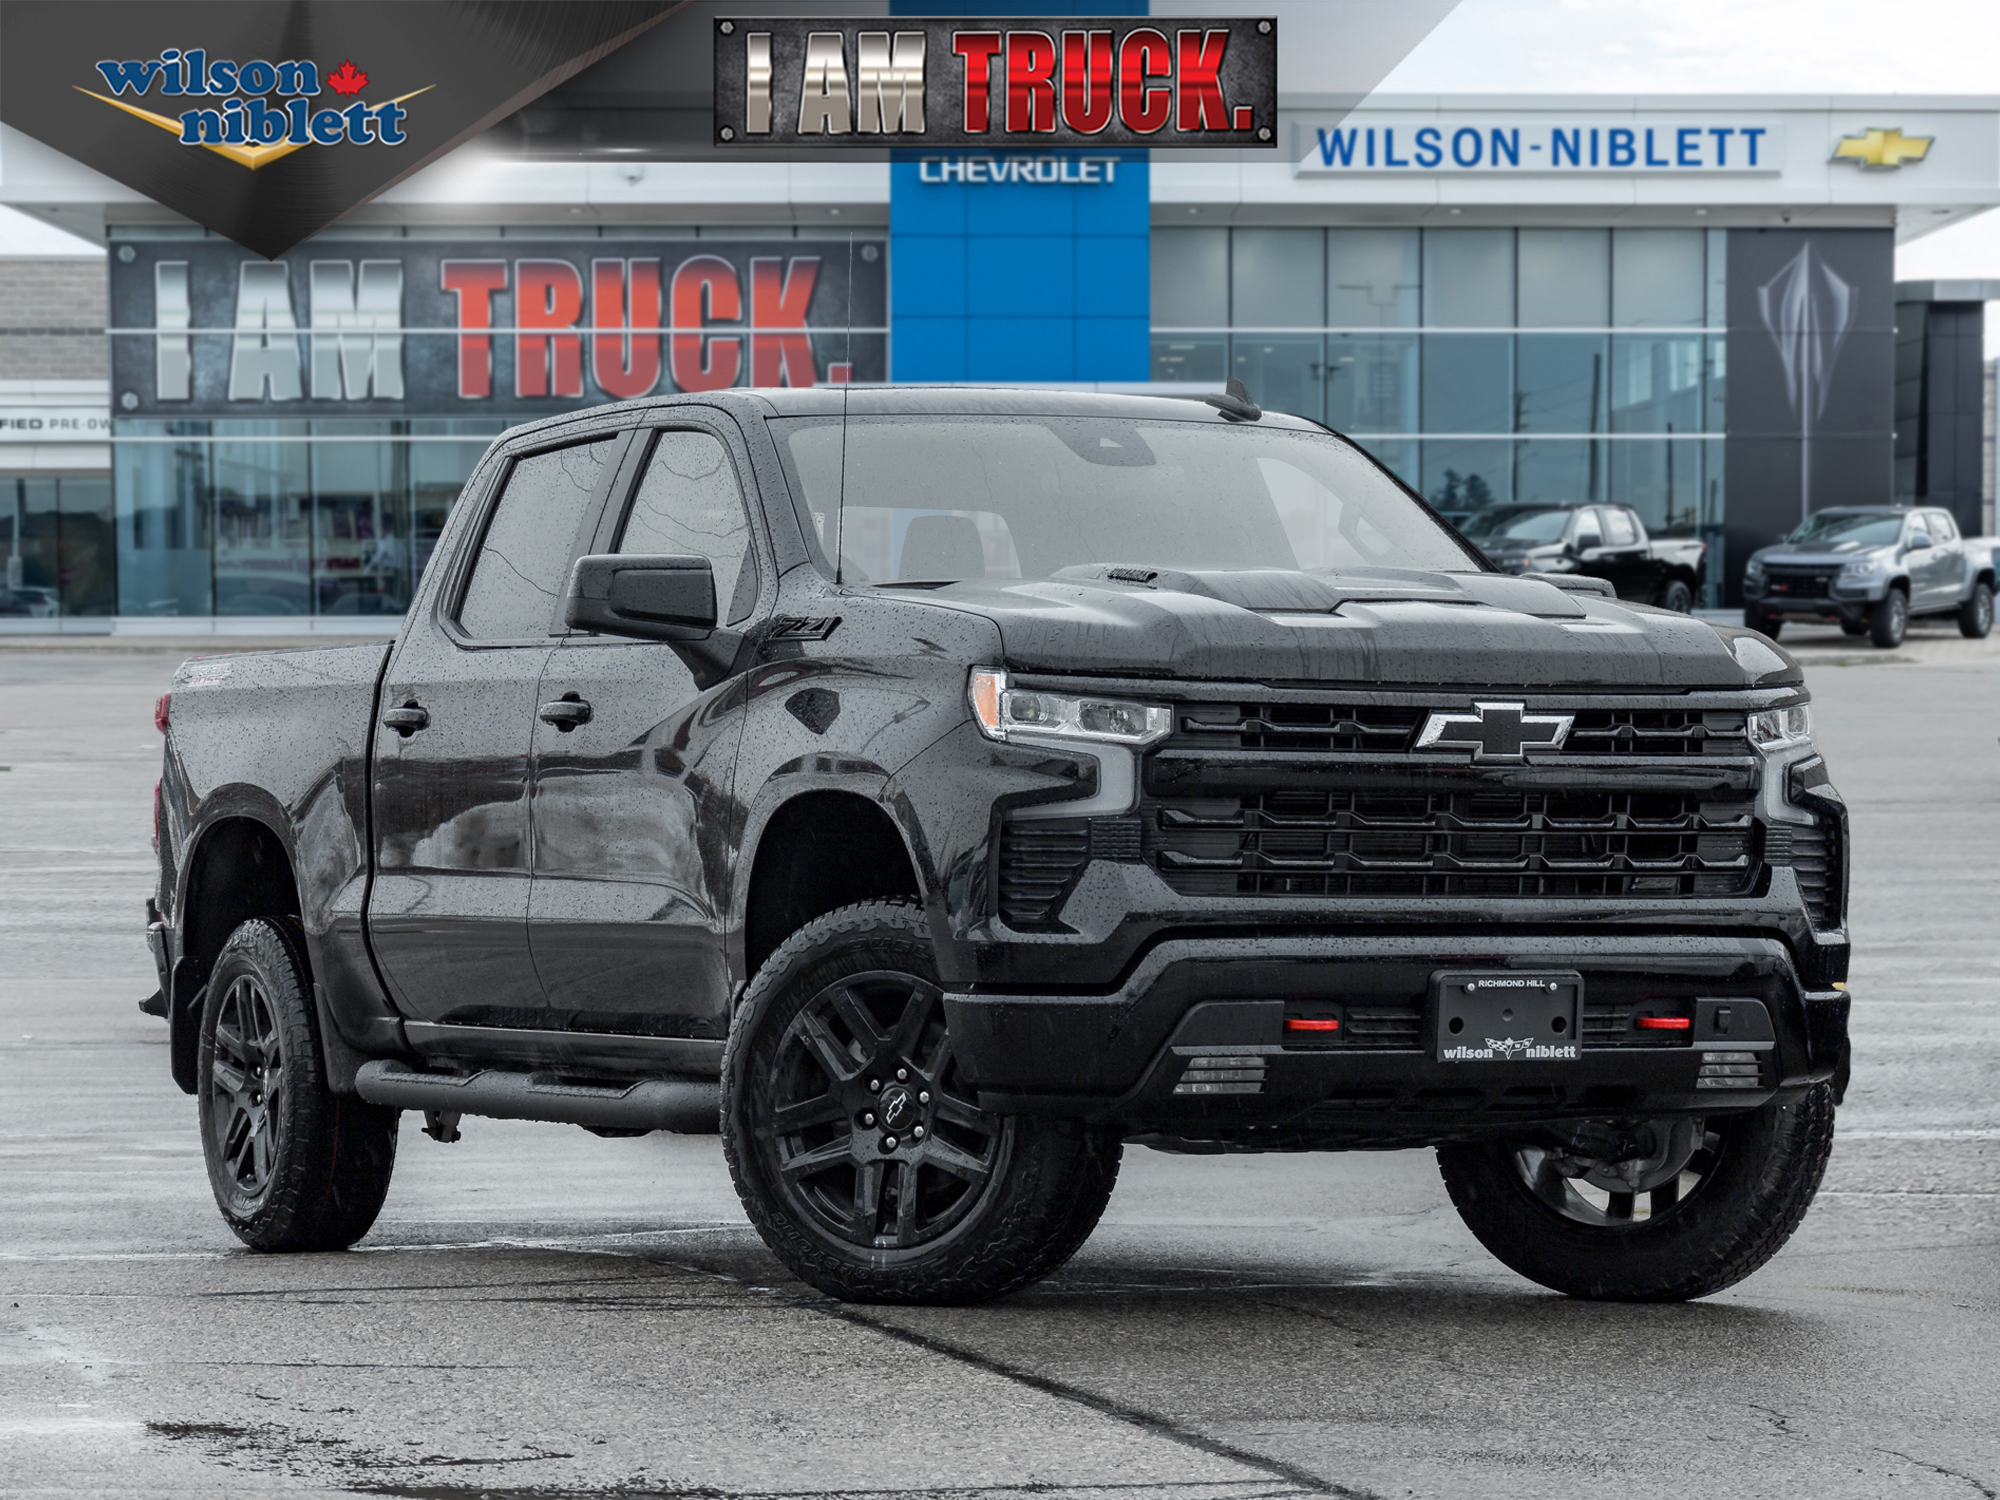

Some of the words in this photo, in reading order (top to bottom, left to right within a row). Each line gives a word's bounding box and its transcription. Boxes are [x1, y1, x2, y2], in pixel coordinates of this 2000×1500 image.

[1316, 127, 1767, 168] WILSON-NIBLETT
[920, 156, 1121, 183] CHEVROLET
[155, 261, 192, 400] I
[228, 261, 404, 400] AM
[441, 254, 853, 400] TRUCK.
[1478, 979, 1525, 988] RICHMOND
[1526, 979, 1546, 987] HILL
[1443, 1046, 1494, 1059] wilson
[1525, 1045, 1576, 1058] niblett
